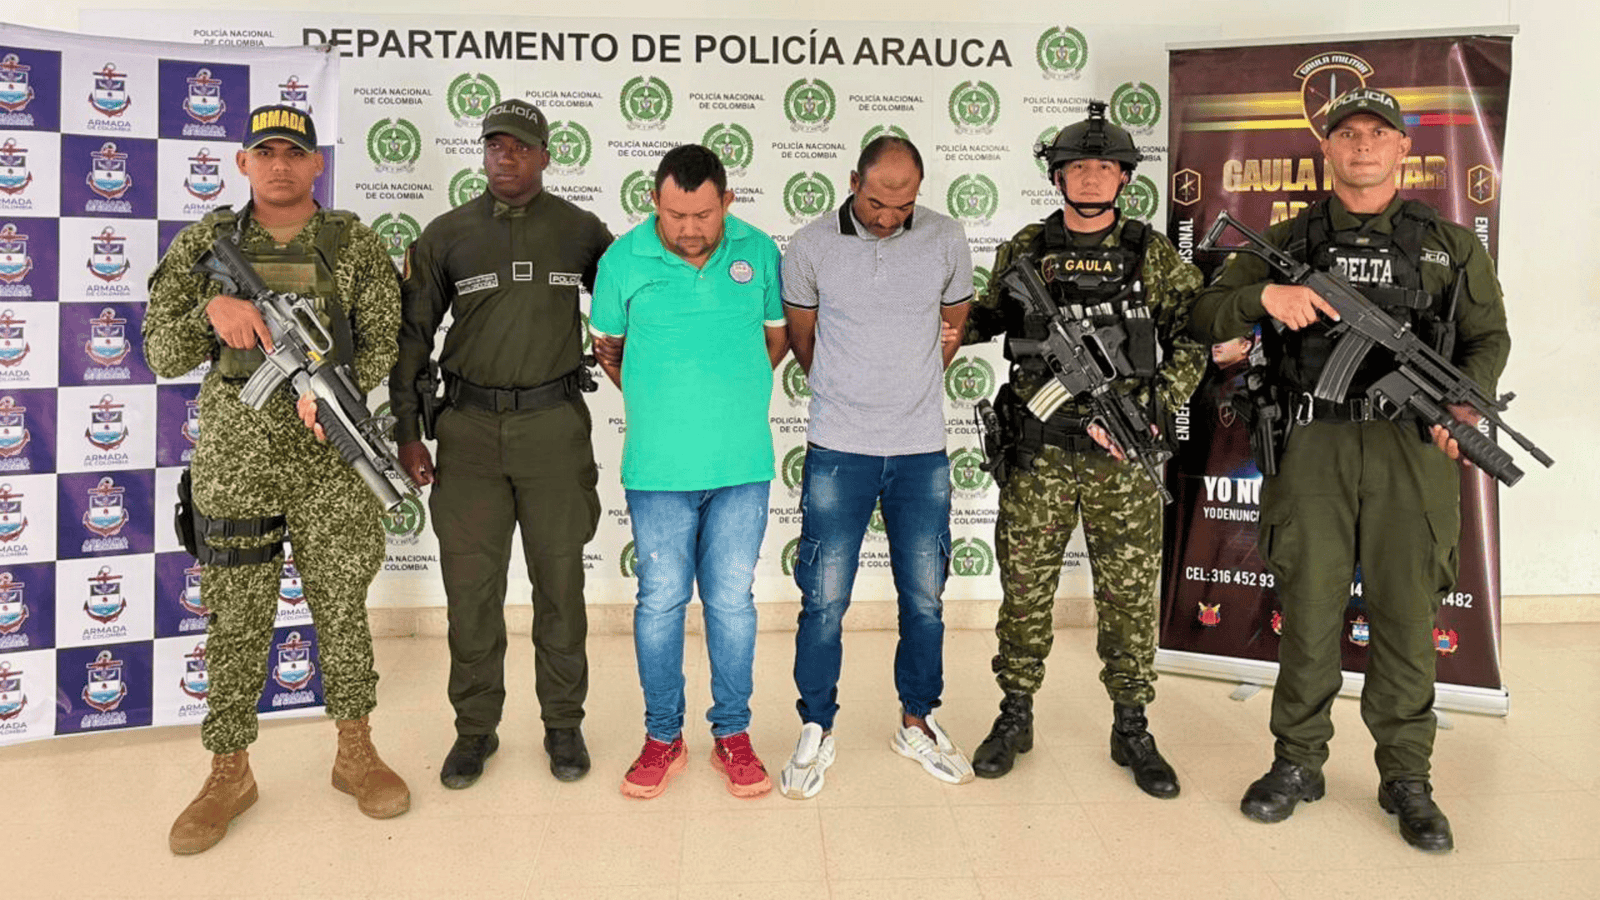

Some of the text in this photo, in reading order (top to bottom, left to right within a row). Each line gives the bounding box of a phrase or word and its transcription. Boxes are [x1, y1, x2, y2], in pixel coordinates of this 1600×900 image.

[193, 28, 274, 38] POLICÍA NACIONAL
[204, 38, 264, 47] DE COLOMBIA
[302, 28, 1013, 68] DEPARTAMENTO DE POLICÍA ARAUCA
[353, 86, 432, 97] POLICÍA NACIONAL
[525, 89, 603, 99] POLICÍA NACIONAL
[364, 97, 423, 105] DE COLOMBIA
[689, 92, 764, 101] POLICÍA NACIONAL
[849, 94, 924, 103] POLICÍA NACIONAL
[1023, 95, 1055, 104] POLICÍA
[535, 99, 594, 108] DE COLOMBIA
[699, 102, 755, 110] DE COLOMBIA
[858, 103, 914, 112] DE COLOMBIA
[1032, 105, 1044, 113] DE
[87, 119, 131, 127] ARMADA
[252, 109, 307, 134] ARMADA
[435, 136, 468, 146] POLICÍA
[608, 139, 640, 148] POLICÍA
[445, 146, 484, 155] DE COLO
[771, 141, 847, 151] POLICÍA NACIONAL
[935, 144, 1010, 153] POLICÍA NACIONAL
[618, 149, 667, 157] DE COLOMB
[781, 151, 838, 160] DE COLOMBIA
[945, 153, 1001, 162] DE COLOMBIA
[1222, 158, 1318, 192] GAULA
[355, 182, 434, 191] POLICÍA NACIONAL
[561, 185, 603, 194] NACIONAL
[730, 187, 764, 195] ACIONAL
[366, 192, 424, 200] DE COLOMBIA
[1178, 218, 1193, 263] RSONAL
[1065, 259, 1113, 272] GAULA
[1336, 256, 1393, 283] DELTA
[86, 284, 131, 292] ARMADA
[0, 369, 30, 377] MADA
[770, 415, 803, 425] POLICÍA
[85, 453, 129, 462] ARMADA
[1203, 475, 1232, 503] YO
[1217, 508, 1260, 522] DENUNCI
[779, 516, 790, 524] DE
[954, 517, 996, 525] COLOMBIA
[395, 554, 438, 562] NACIONAL
[384, 563, 428, 571] COLOMBIA
[867, 560, 891, 568] COLO
[1233, 570, 1257, 586] 452
[274, 607, 312, 617] ARMAD
[83, 625, 127, 636] ARMADA
[179, 704, 209, 712] ARMA
